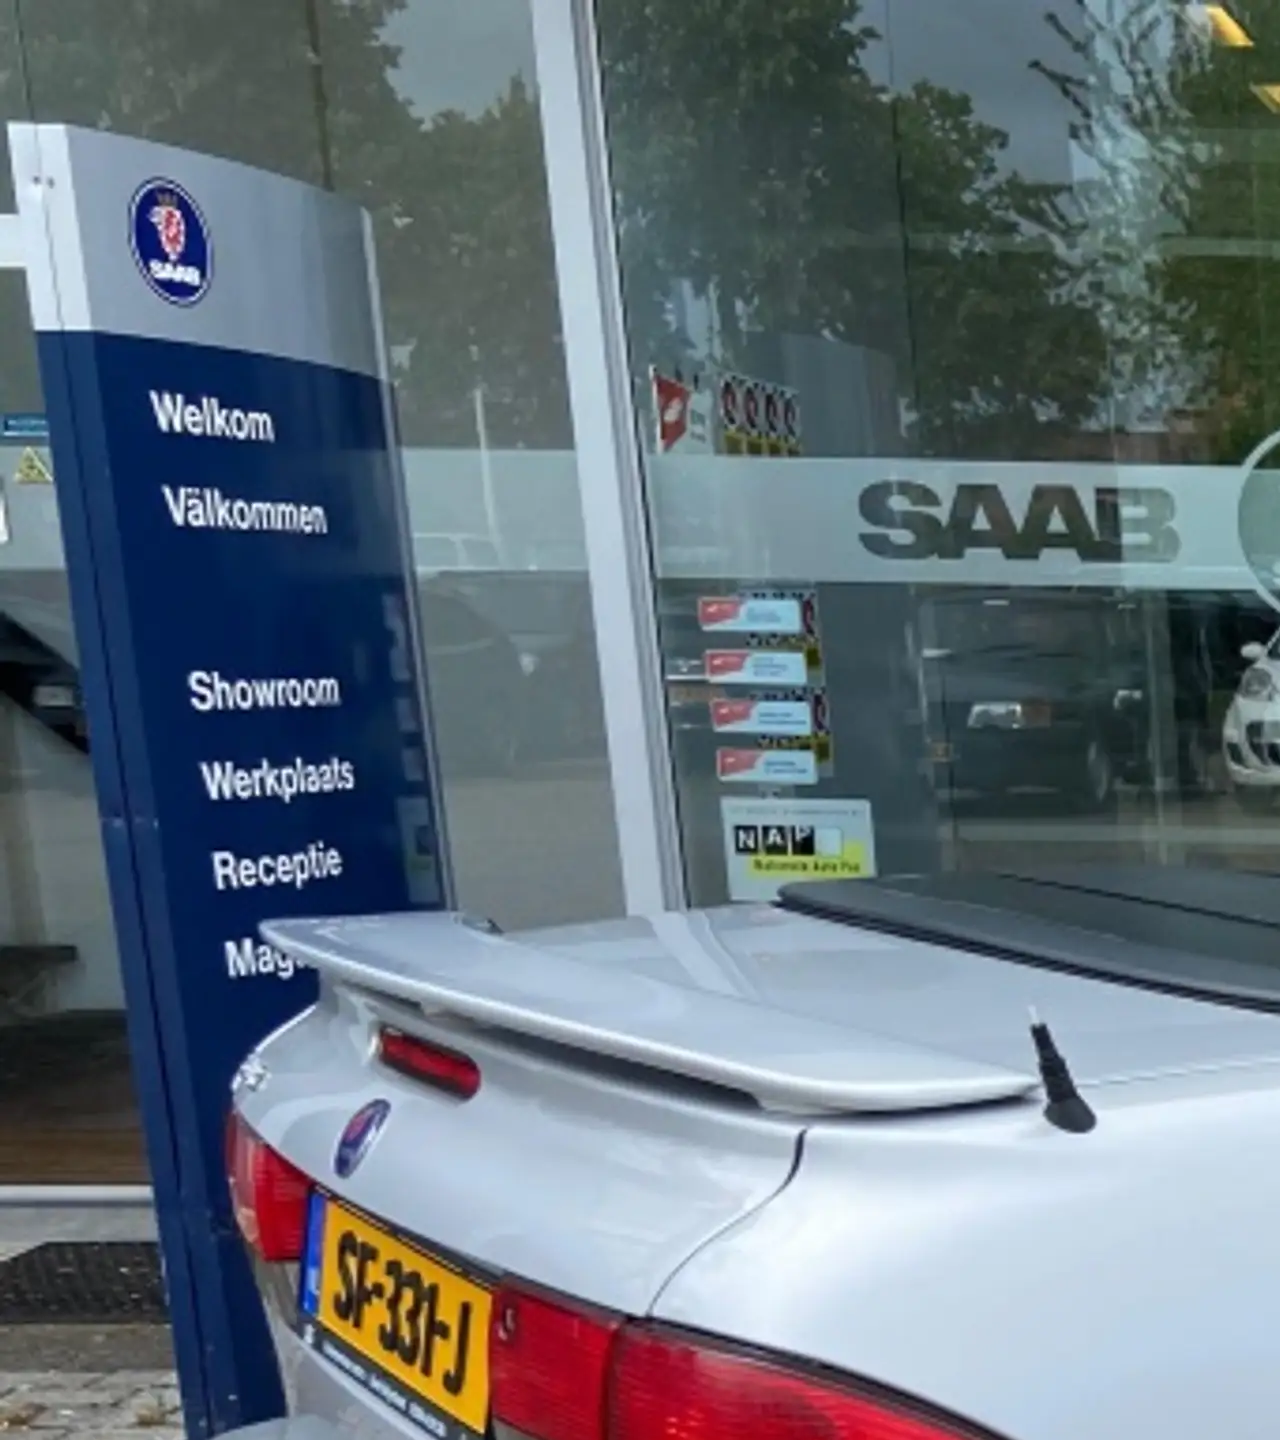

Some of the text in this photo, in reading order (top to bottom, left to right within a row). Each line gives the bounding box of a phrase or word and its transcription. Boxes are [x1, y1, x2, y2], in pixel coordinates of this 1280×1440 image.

[149, 259, 200, 286] SAAB
[149, 390, 275, 443] Welkom
[162, 485, 328, 535] Välkommen
[858, 480, 1181, 562] SAAB
[188, 670, 340, 711] Showroom
[199, 757, 355, 802] Werkplaats
[212, 841, 343, 890] Receptie
[225, 938, 315, 979] Mag
